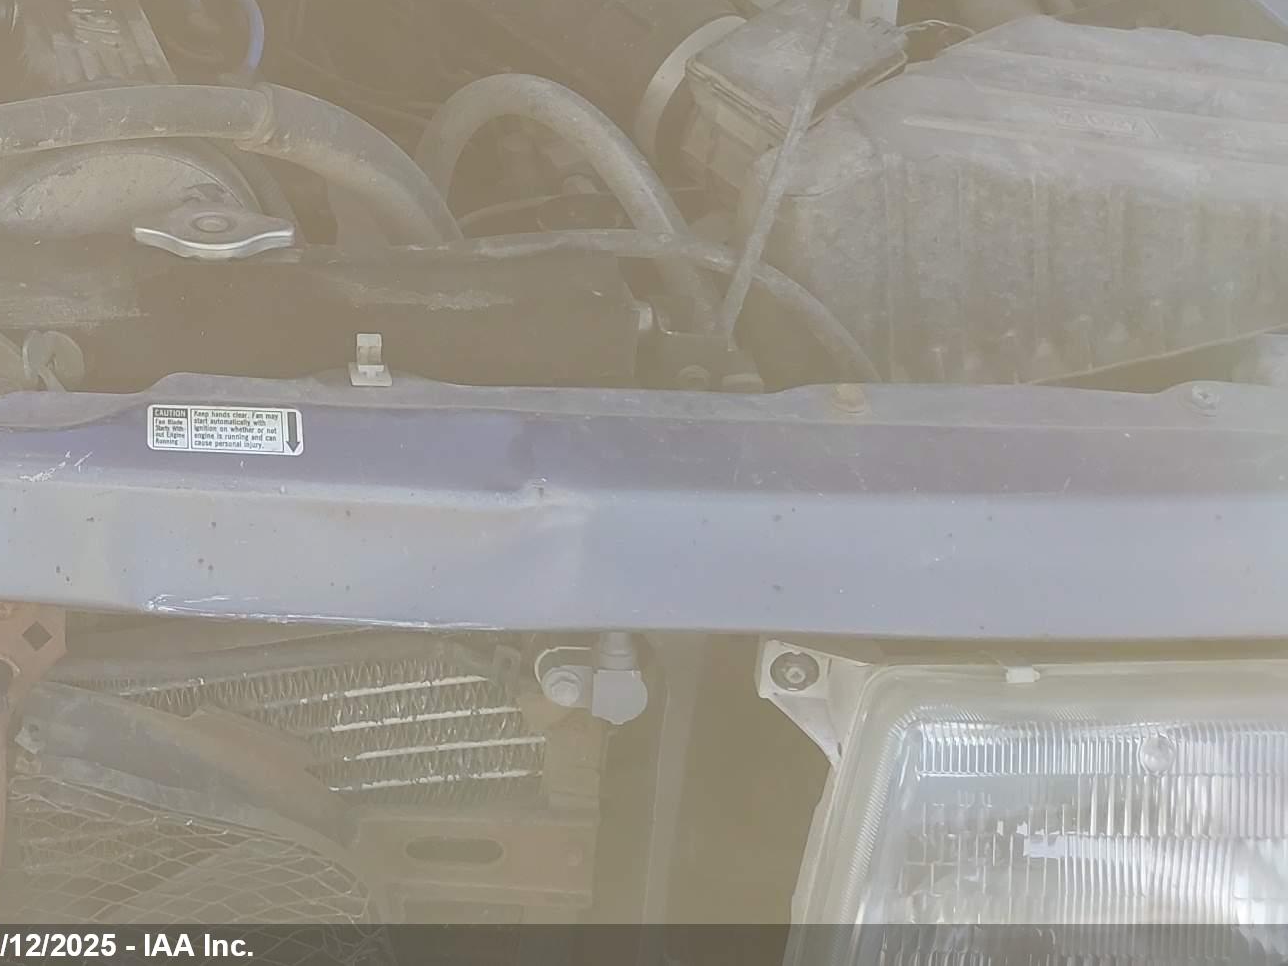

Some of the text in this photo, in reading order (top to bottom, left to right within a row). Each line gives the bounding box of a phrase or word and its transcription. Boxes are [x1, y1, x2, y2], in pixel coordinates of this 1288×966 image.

[154, 409, 187, 418] CAUTION
[193, 410, 279, 421] Keep hands clear. Fan may
[194, 425, 217, 433] ignition
[155, 438, 178, 446] Running
